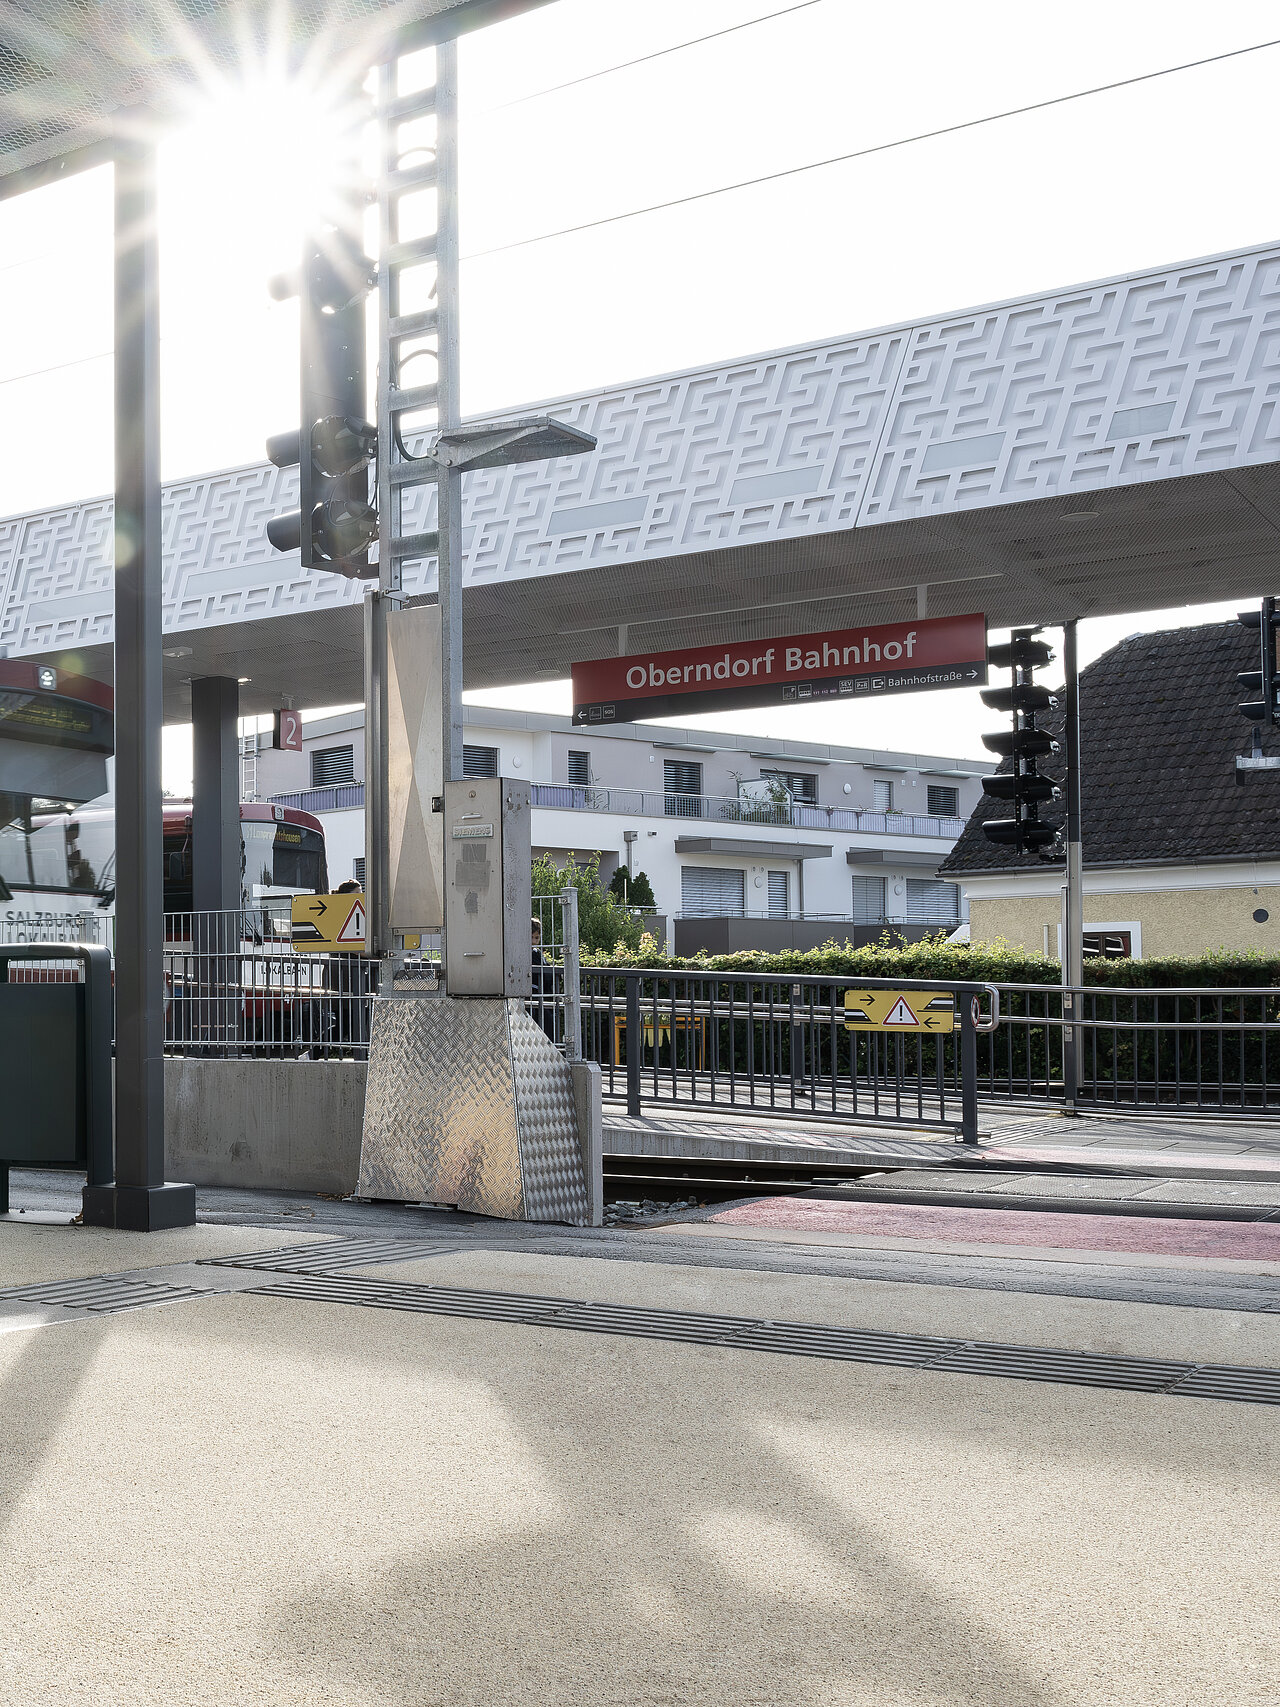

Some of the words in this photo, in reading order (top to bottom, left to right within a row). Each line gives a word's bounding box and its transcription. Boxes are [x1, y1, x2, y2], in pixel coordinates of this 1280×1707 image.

[625, 649, 775, 690] Oberndorf
[785, 631, 917, 672] Bahnhof
[888, 671, 962, 687] Bahnhofstraße
[287, 717, 296, 746] 2
[454, 827, 491, 837] SIEMENS
[5, 911, 101, 930] SALZBURGR
